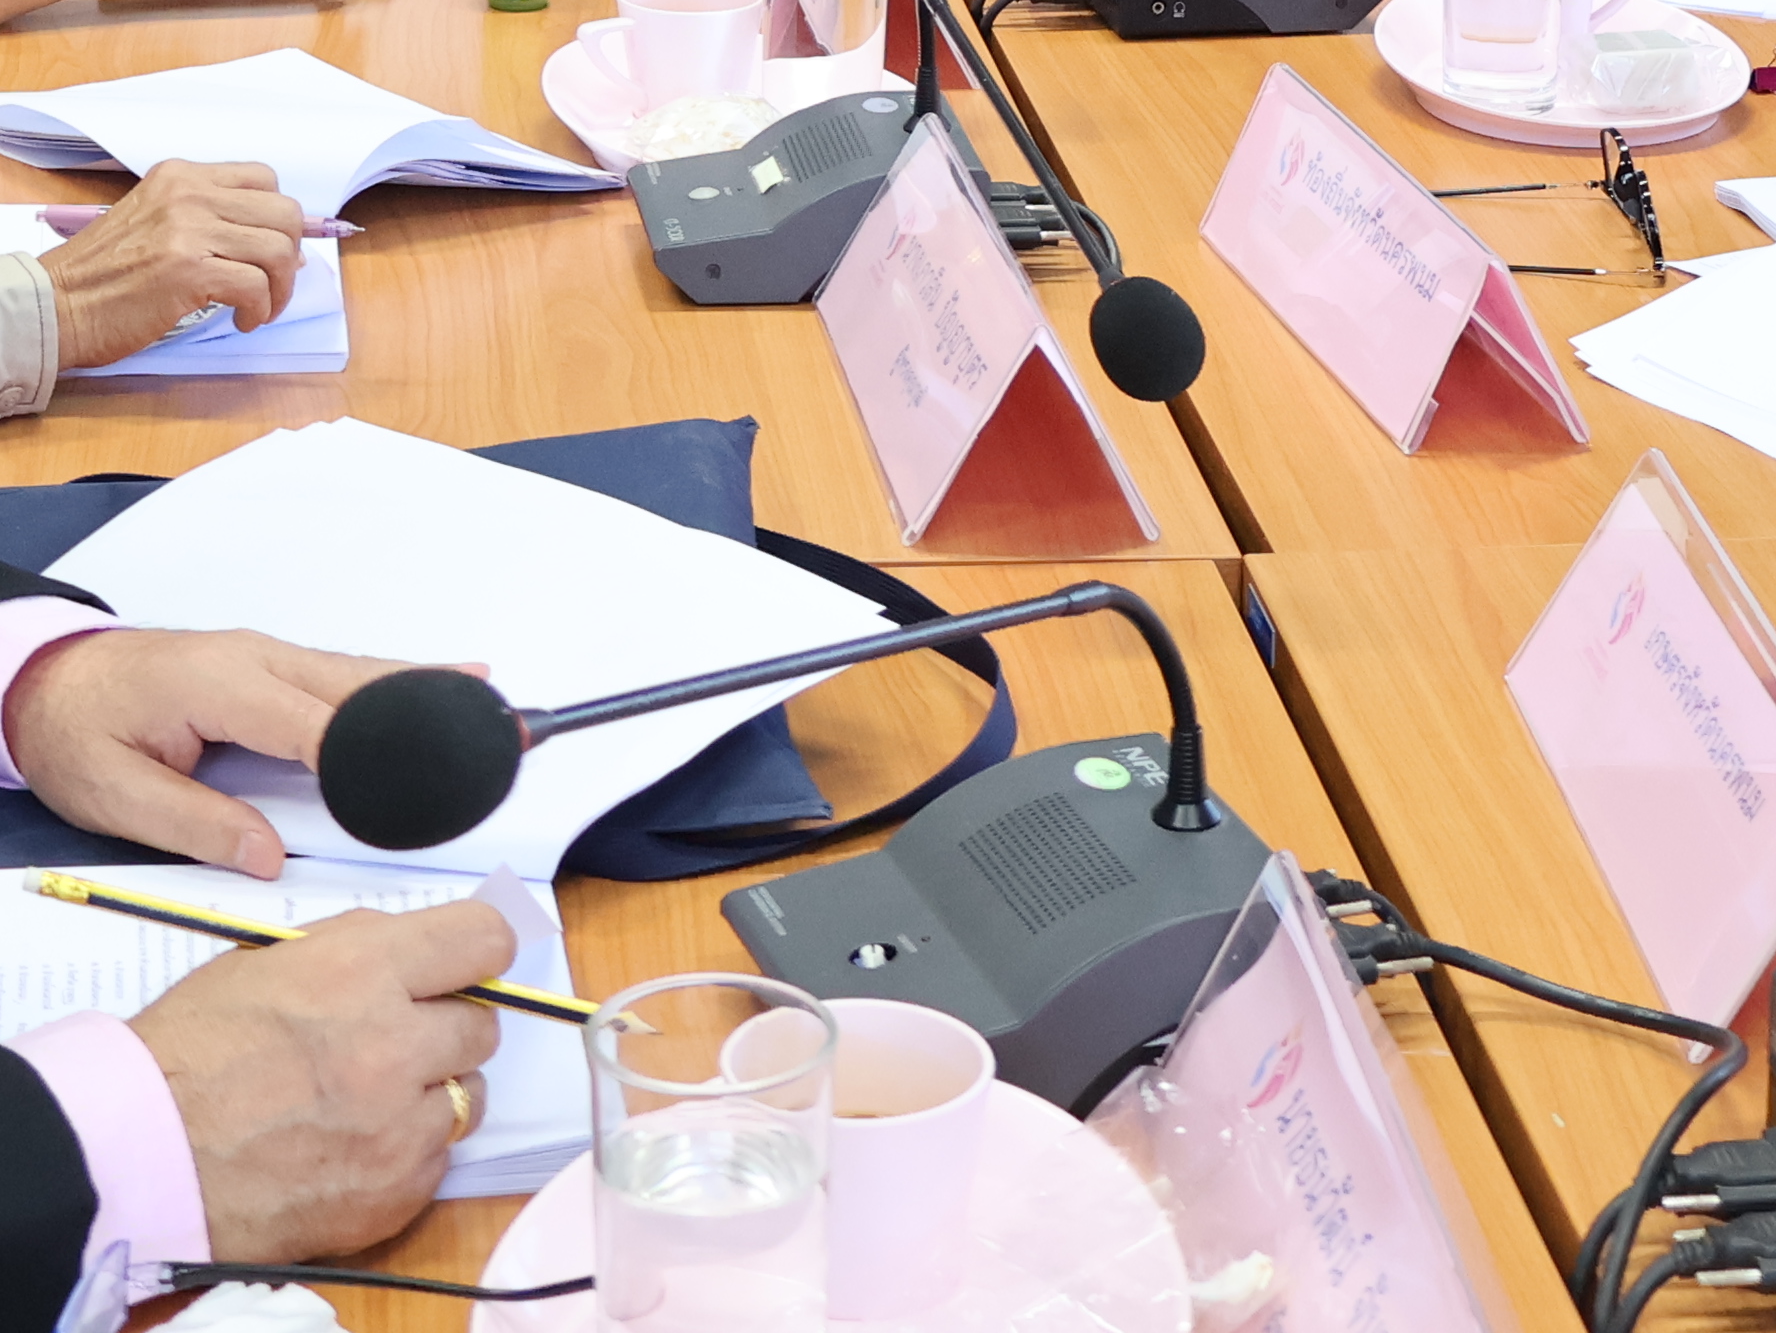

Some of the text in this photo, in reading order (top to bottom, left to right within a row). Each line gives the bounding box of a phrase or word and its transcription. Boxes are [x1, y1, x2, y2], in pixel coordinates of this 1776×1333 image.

[1302, 151, 1440, 303] ท้องถิ่นจังหวัดนครพนม
[1122, 746, 1170, 787] NPE
[1645, 627, 1767, 823] เกษตรจังหวัดนครพนม
